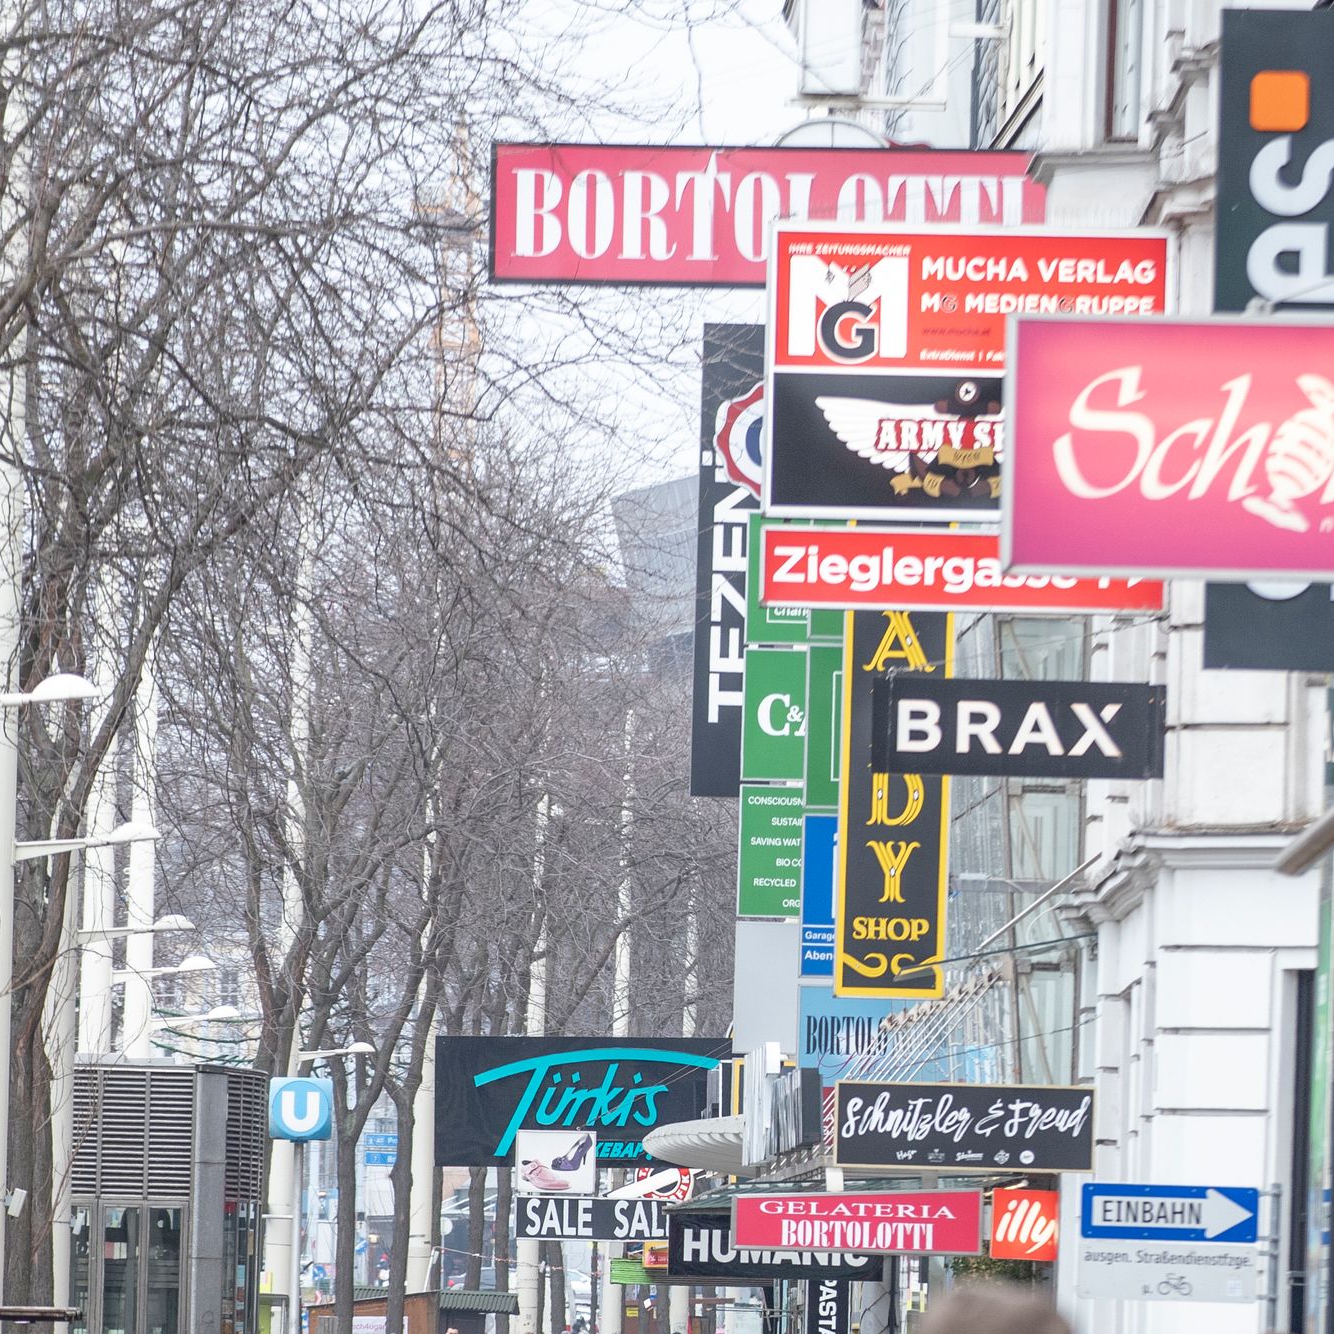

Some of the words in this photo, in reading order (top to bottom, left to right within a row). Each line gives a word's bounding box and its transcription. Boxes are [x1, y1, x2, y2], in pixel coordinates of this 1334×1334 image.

[788, 243, 813, 254] IHRE
[815, 243, 912, 257] ZEITUNGSMACHER
[921, 256, 1029, 283] MUCHA
[1037, 258, 1157, 285] VERLAG
[964, 294, 1157, 316] MEDIENGRUPPE
[876, 419, 966, 451] ARMY
[895, 698, 1124, 759] BRAX
[750, 837, 783, 847] SAVING
[775, 858, 791, 868] BIO
[753, 877, 797, 889] RECYCLED
[852, 916, 930, 942] SHOP
[280, 1091, 320, 1133] U
[473, 1047, 721, 1158] Türkis
[842, 1091, 975, 1143] Schnitzler
[974, 1098, 1005, 1138] &
[1003, 1095, 1092, 1141] Freud
[525, 1198, 594, 1237] SALE
[613, 1200, 668, 1239] SAL
[759, 1199, 957, 1220] GELATERIA
[1102, 1199, 1203, 1225] EINBAHN
[781, 1219, 934, 1251] BORTOLOTTI
[995, 1198, 1058, 1255] illy
[1083, 1250, 1133, 1266] ausgen.
